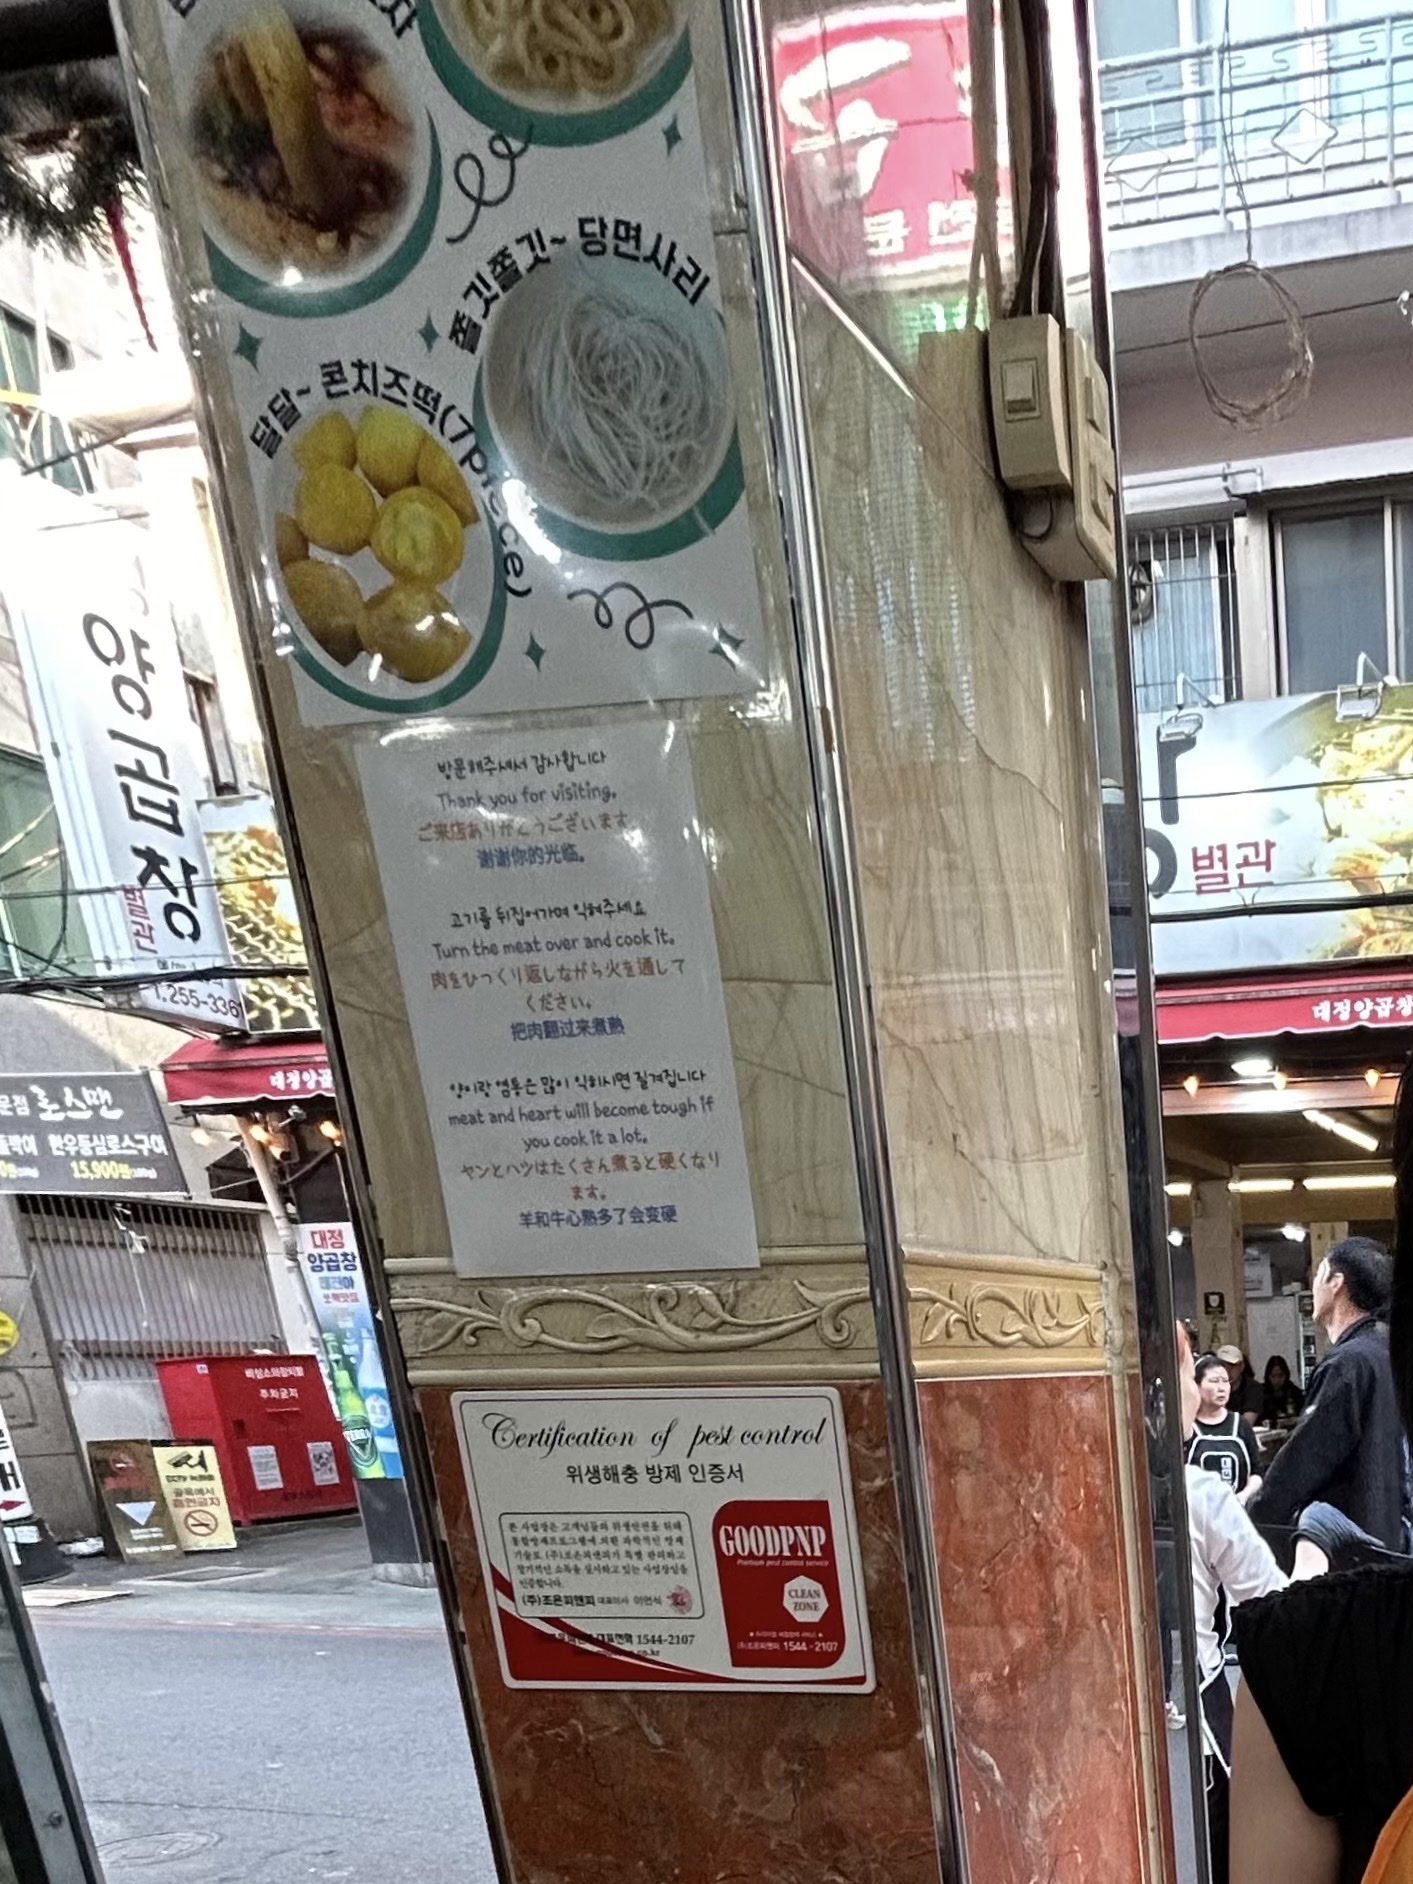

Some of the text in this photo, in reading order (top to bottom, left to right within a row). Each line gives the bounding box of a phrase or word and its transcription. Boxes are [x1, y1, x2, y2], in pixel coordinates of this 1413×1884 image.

[578, 216, 710, 306] 당면사리
[530, 750, 607, 775] 감사합니다
[81, 612, 202, 943] 양곱창
[436, 780, 617, 810] Thank you for visiting.
[1192, 839, 1277, 895] 별관
[451, 898, 647, 931] 고기를 뒤집어가며 익혀주세요
[432, 926, 676, 961] Turn the meat over and cook it.
[525, 993, 593, 1013] ください。
[633, 1068, 707, 1090] 질겨집니다
[448, 1094, 715, 1126] meat and heart will become tough if
[523, 1126, 648, 1154] you cook it a lot.
[570, 1183, 607, 1202] ます。
[310, 1229, 345, 1249] 대정
[307, 1251, 358, 1273] 양곱창
[482, 1412, 828, 1459] Certification of pest control
[566, 1462, 745, 1485] 위생해충 방제 인증서
[719, 1525, 826, 1557] GOODPNP
[788, 1588, 821, 1599] CLEAN
[792, 1601, 820, 1612] ZONE
[637, 1634, 696, 1646] 1544-2107
